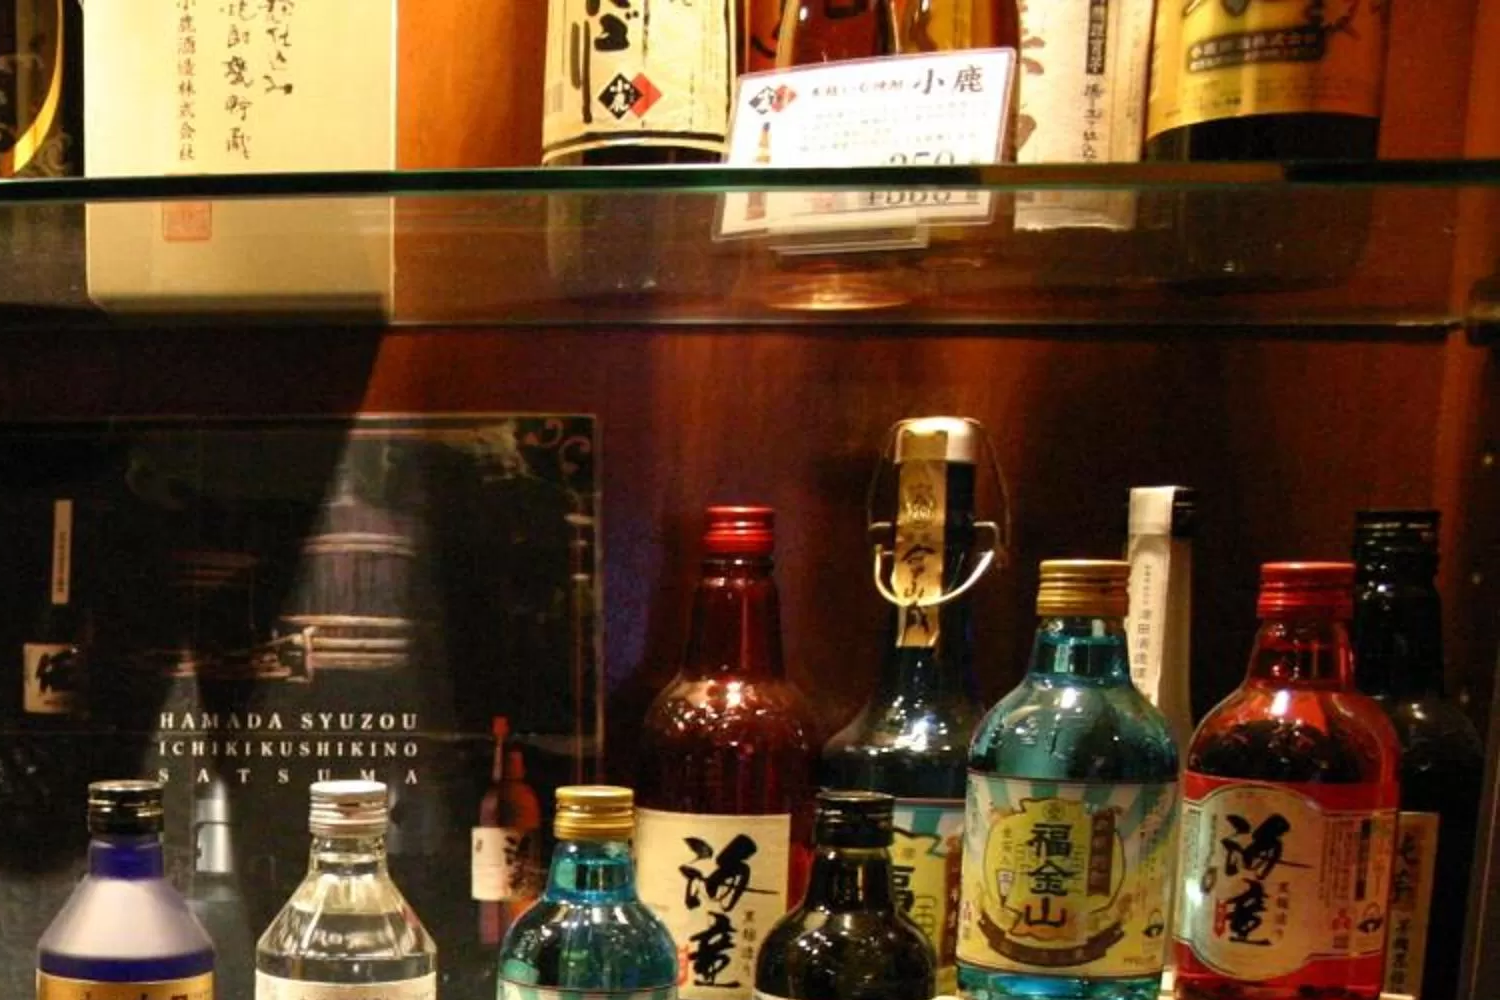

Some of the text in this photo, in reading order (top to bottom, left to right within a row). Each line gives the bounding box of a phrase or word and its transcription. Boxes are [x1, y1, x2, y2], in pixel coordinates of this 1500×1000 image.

[912, 65, 984, 96] 小鹿
[160, 712, 419, 731] HAMADA SYUZOU
[159, 740, 419, 758] ICHIKIKUSHIKINO
[1024, 820, 1077, 931] 福金山
